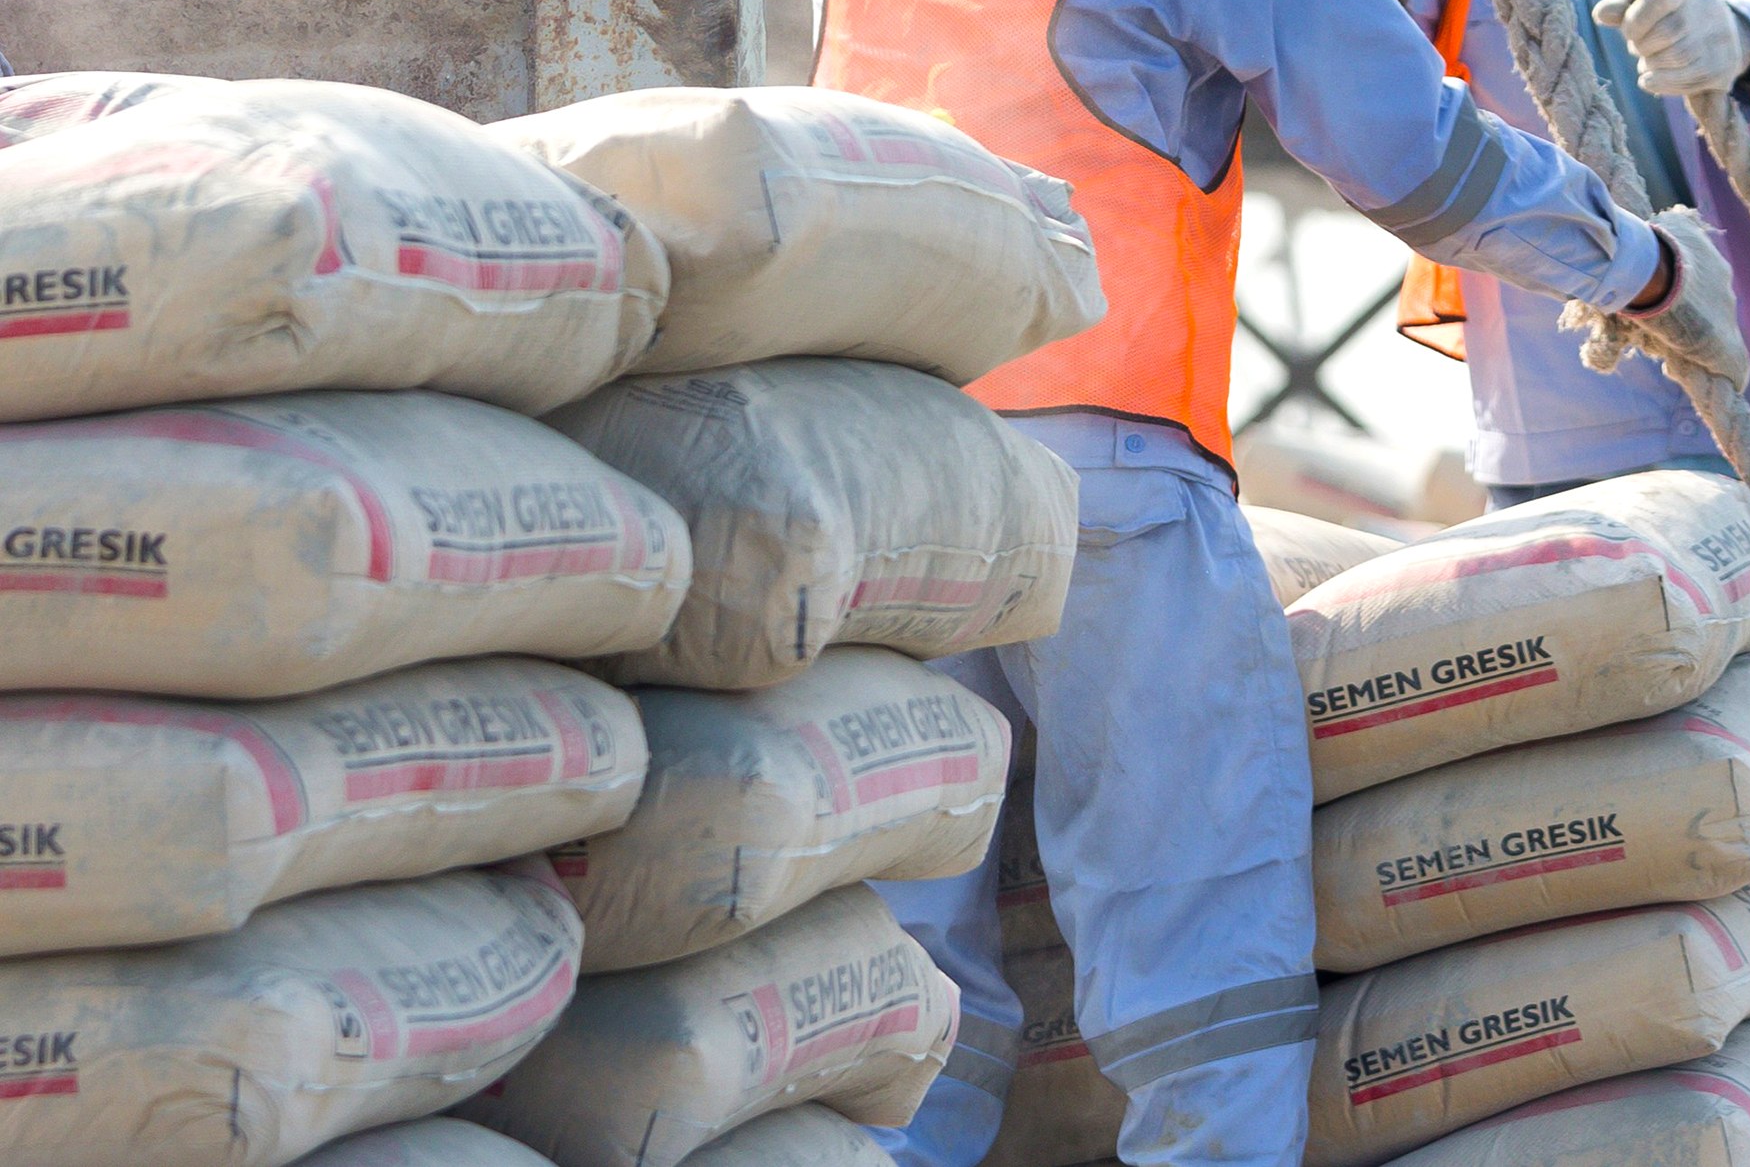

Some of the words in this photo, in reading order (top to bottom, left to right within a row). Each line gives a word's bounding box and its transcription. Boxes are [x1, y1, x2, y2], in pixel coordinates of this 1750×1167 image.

[0, 265, 129, 305] RESIK
[4, 526, 168, 565] GRESIK
[1307, 667, 1422, 716] SEMEN
[1430, 636, 1552, 685] GRESIK
[312, 700, 436, 756] SEMEN
[430, 697, 552, 745] GRESIK
[827, 702, 915, 762] SEMEN
[906, 694, 974, 742] GRESIK
[1375, 838, 1494, 885] SEMEN
[1501, 813, 1624, 857] GRESIK
[378, 957, 489, 1009] SEMEN
[788, 959, 864, 1031] SEMEN
[867, 941, 921, 1004] GRESIK
[1344, 1028, 1453, 1083] SEMEN
[1458, 994, 1576, 1045] GRESIK
